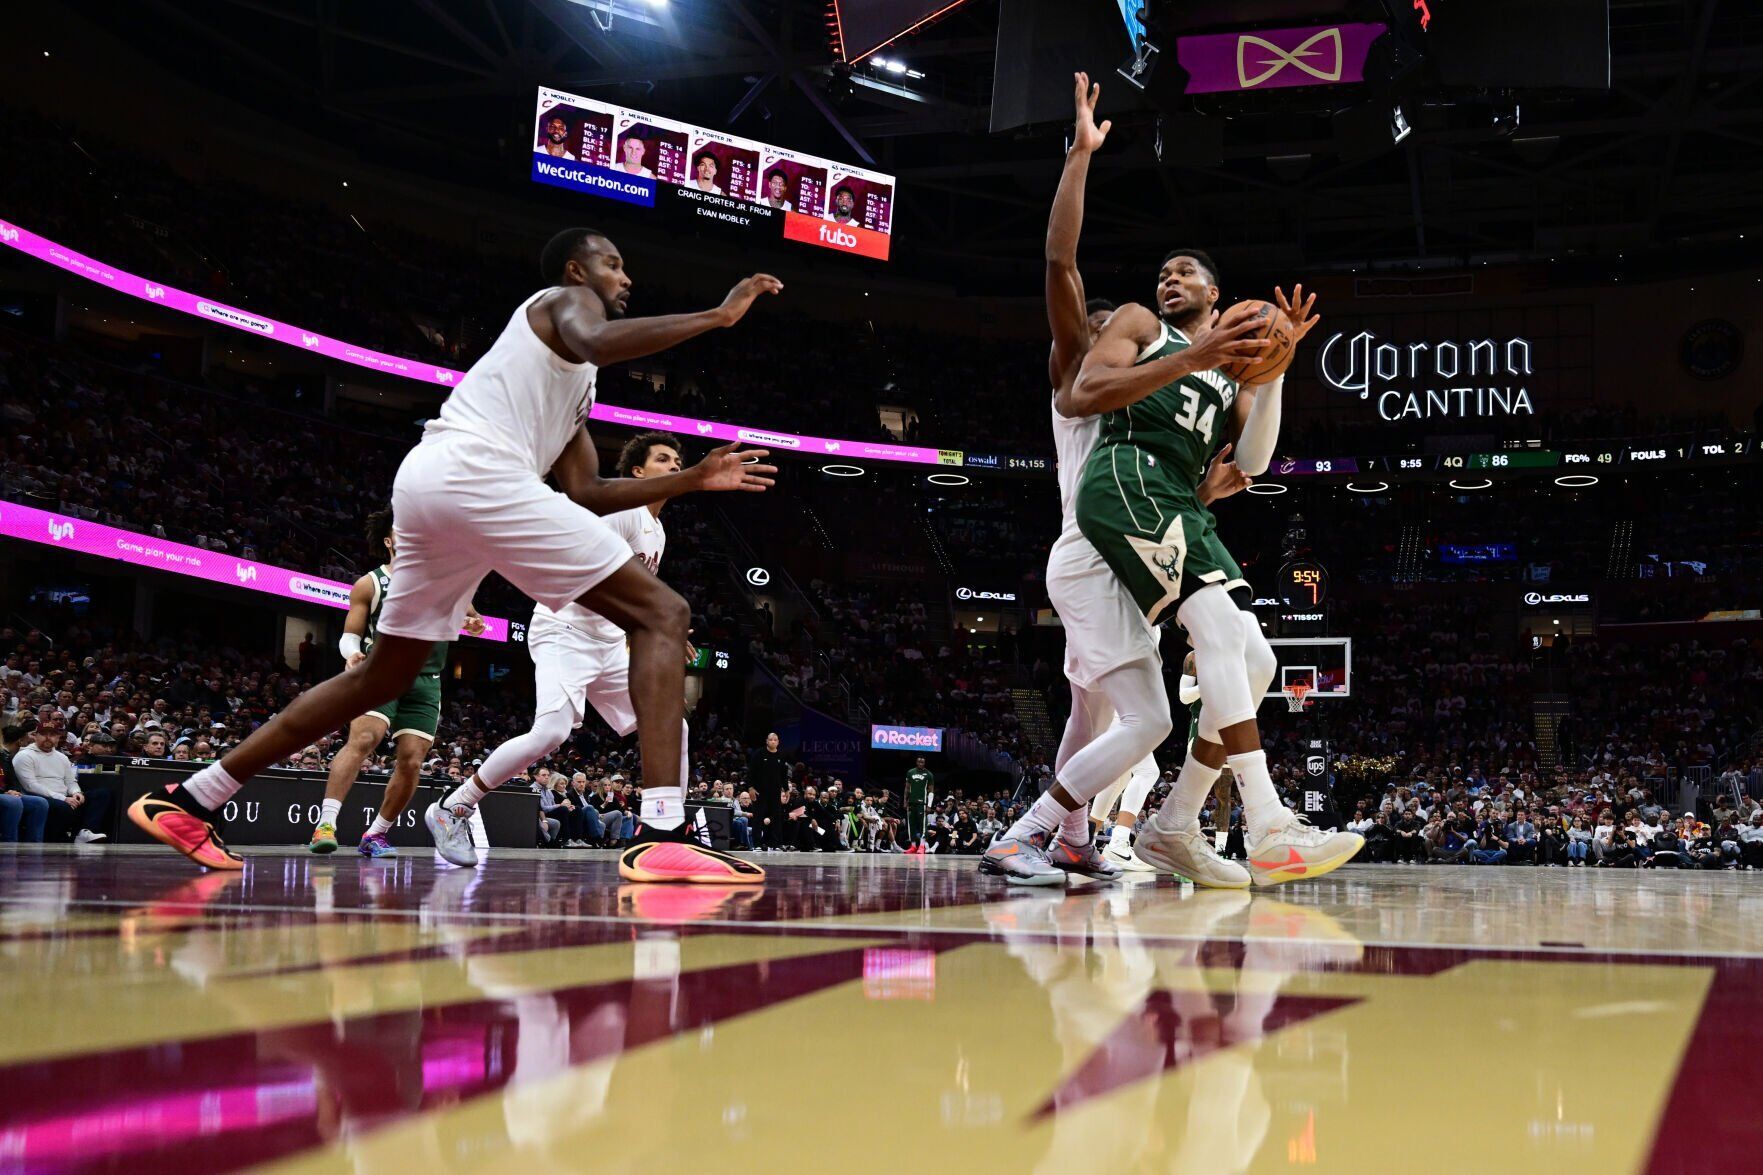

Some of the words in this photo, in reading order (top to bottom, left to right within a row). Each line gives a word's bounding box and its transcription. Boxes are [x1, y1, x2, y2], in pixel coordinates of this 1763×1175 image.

[551, 93, 575, 102] MOBLEY
[628, 113, 652, 122] MERRILL
[584, 123, 597, 131] PTS:
[584, 130, 593, 138] TO:
[702, 132, 724, 140] PORTER
[583, 137, 598, 145] BLK:
[582, 143, 596, 151] AST:
[659, 155, 672, 163] BLK:
[773, 150, 795, 159] HUNTER
[537, 161, 649, 197] WeCutCarbon.com
[731, 172, 744, 181] BLK:
[801, 176, 814, 184] PTS:
[730, 179, 744, 187] AST:
[800, 190, 813, 198] BLK:
[868, 193, 878, 201] PTS:
[678, 189, 702, 200] CRAIG
[704, 195, 735, 208] PORTER
[736, 203, 747, 211] JR.
[750, 206, 771, 216] FROM
[800, 196, 812, 204] AST:
[697, 208, 717, 218] EVAN
[866, 205, 878, 213] BLK:
[866, 212, 877, 220] AST:
[819, 224, 857, 248] fubo
[49, 248, 69, 263] Game
[70, 258, 85, 269] plan
[86, 264, 100, 275] your
[101, 270, 114, 281] ride
[145, 283, 164, 299] lyft
[211, 308, 228, 318] Where
[240, 317, 249, 325] you
[250, 320, 268, 330] going?
[302, 334, 319, 347] lyft
[345, 349, 363, 360] Game
[364, 354, 379, 364] plan
[380, 359, 394, 368] your
[394, 362, 407, 371] ride
[1320, 331, 1533, 400] Corona
[436, 370, 453, 382] lyft
[1378, 387, 1534, 420] CANTINA
[614, 412, 632, 420] Game
[633, 414, 646, 423] plan
[646, 416, 660, 424] your
[660, 418, 672, 426] ride
[1174, 384, 1217, 445] 34
[697, 422, 713, 434] lyft
[825, 441, 840, 452] lyft
[968, 455, 997, 465] oswald
[1316, 461, 1331, 472] 93
[1368, 461, 1374, 469] 7
[1400, 459, 1422, 468] 9:55
[1444, 457, 1464, 468] 4Q
[1492, 455, 1508, 466] 86
[1565, 454, 1590, 463] FG%
[1597, 453, 1612, 464] 49
[1630, 449, 1666, 461] FOULS
[1678, 448, 1684, 458] 1
[1702, 445, 1725, 455] TOL
[1734, 442, 1742, 453] 2
[1009, 458, 1044, 468] $14,155
[48, 518, 75, 540] lyft
[116, 538, 144, 554] Game
[145, 546, 164, 558] plan
[165, 552, 184, 562] your
[185, 555, 202, 566] ride
[236, 563, 257, 582] lyft
[1293, 571, 1319, 582] 9:54
[303, 583, 321, 594] Where
[322, 587, 331, 596] are
[332, 590, 342, 599] you
[972, 591, 1015, 600] LEXUS
[1304, 583, 1316, 604] 7
[1542, 594, 1589, 602] LEXUS
[511, 622, 525, 631] FG%
[512, 631, 524, 641] 46
[716, 659, 728, 669] 49
[888, 730, 938, 746] Rocket
[802, 740, 862, 753] LECOM
[131, 757, 149, 766] anc
[1309, 762, 1323, 773] ups
[1305, 791, 1324, 801] Elk
[1305, 801, 1324, 811] Elk
[223, 801, 260, 823] OU
[288, 804, 320, 824] GO
[364, 807, 416, 827] TIS
